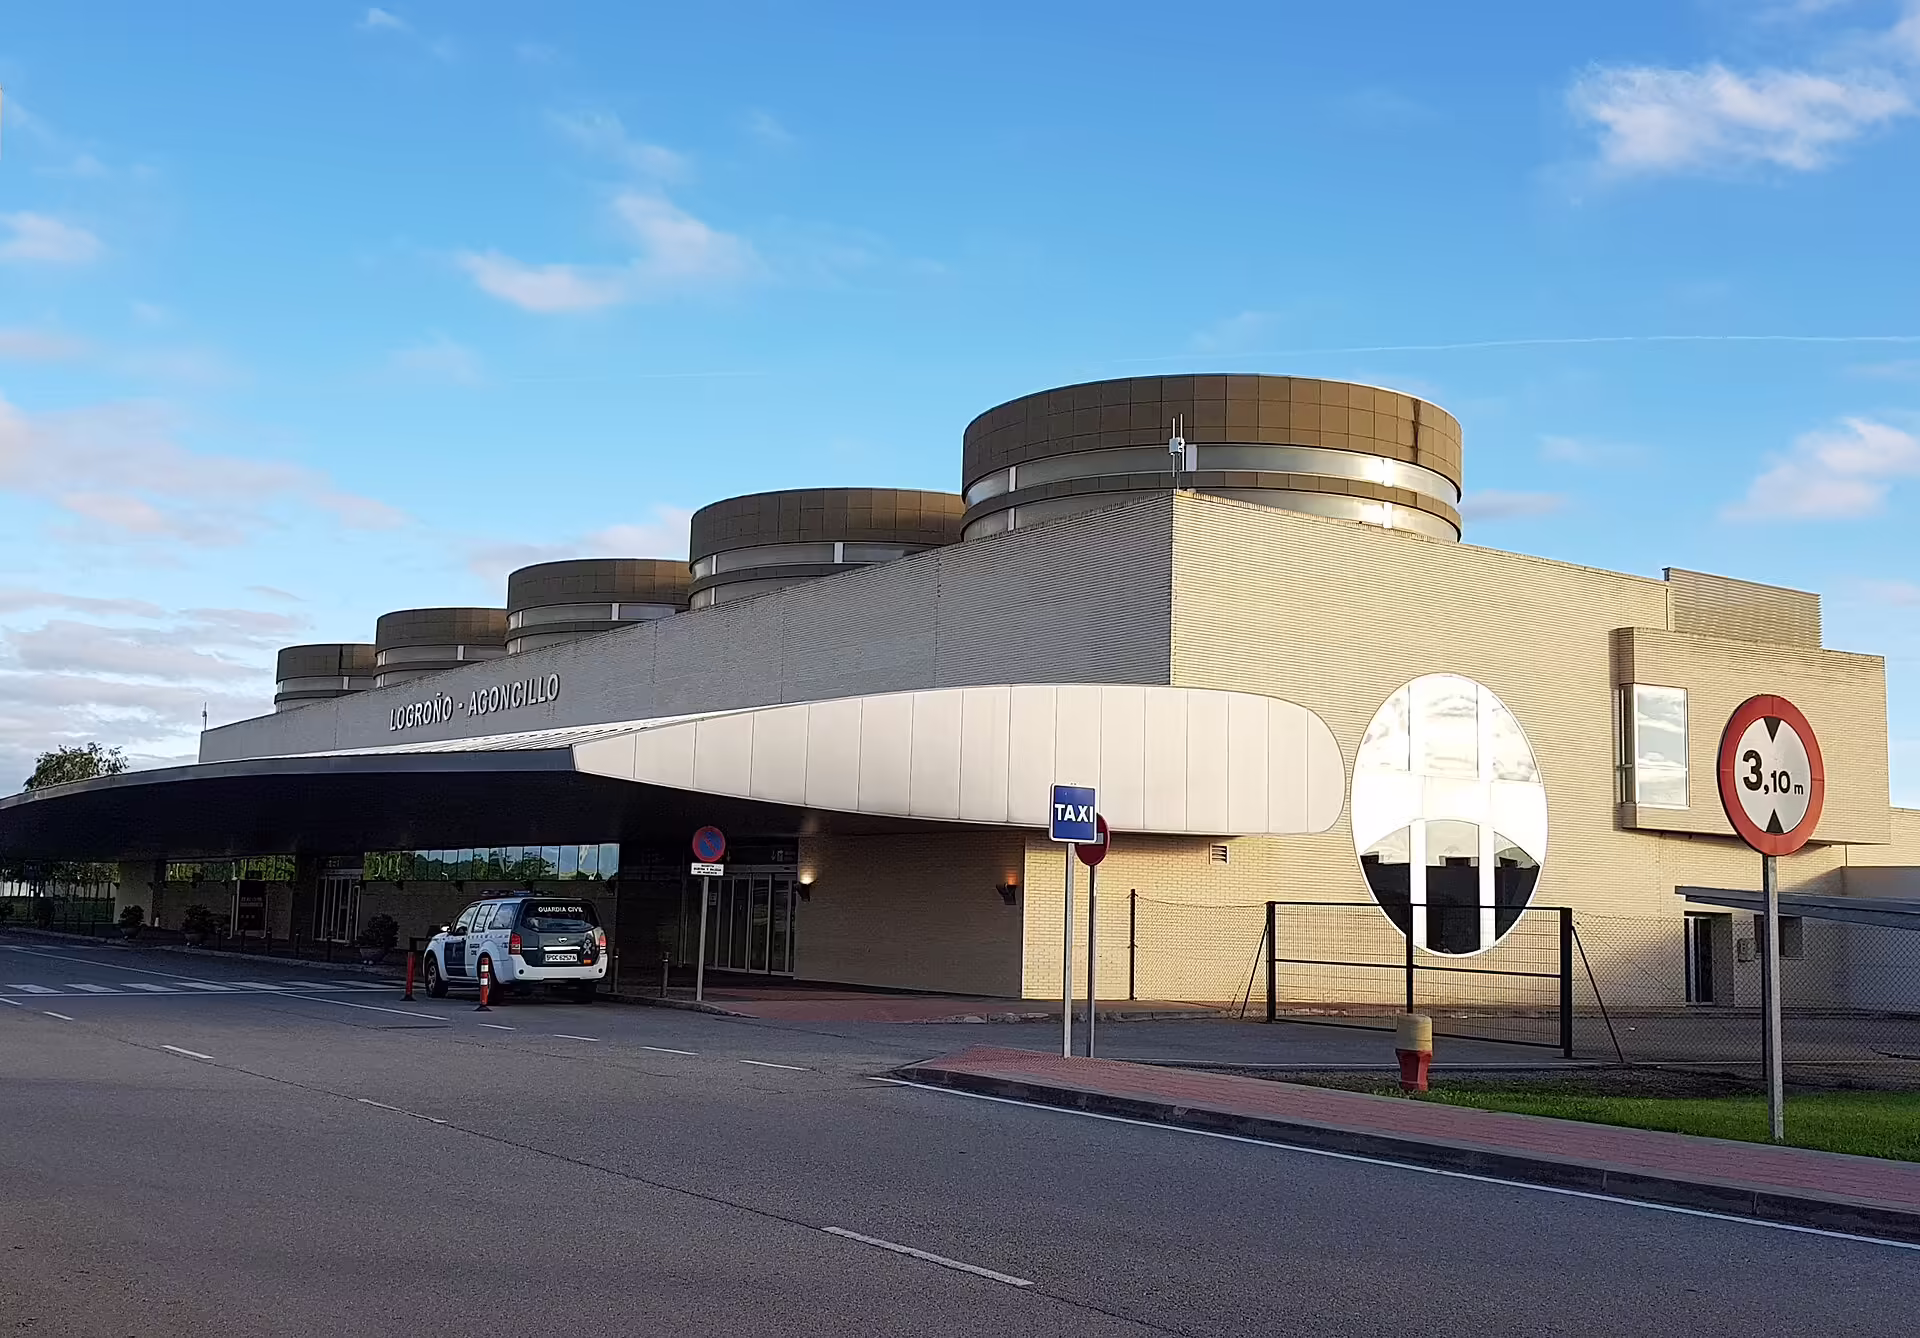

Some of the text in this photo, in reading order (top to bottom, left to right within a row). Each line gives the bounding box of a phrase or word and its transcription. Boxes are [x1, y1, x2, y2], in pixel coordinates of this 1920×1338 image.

[389, 692, 453, 731] LOGROÑO
[468, 673, 560, 717] AGONCILLO
[1742, 749, 1804, 795] 3,10 m
[1054, 803, 1094, 823] TAXI
